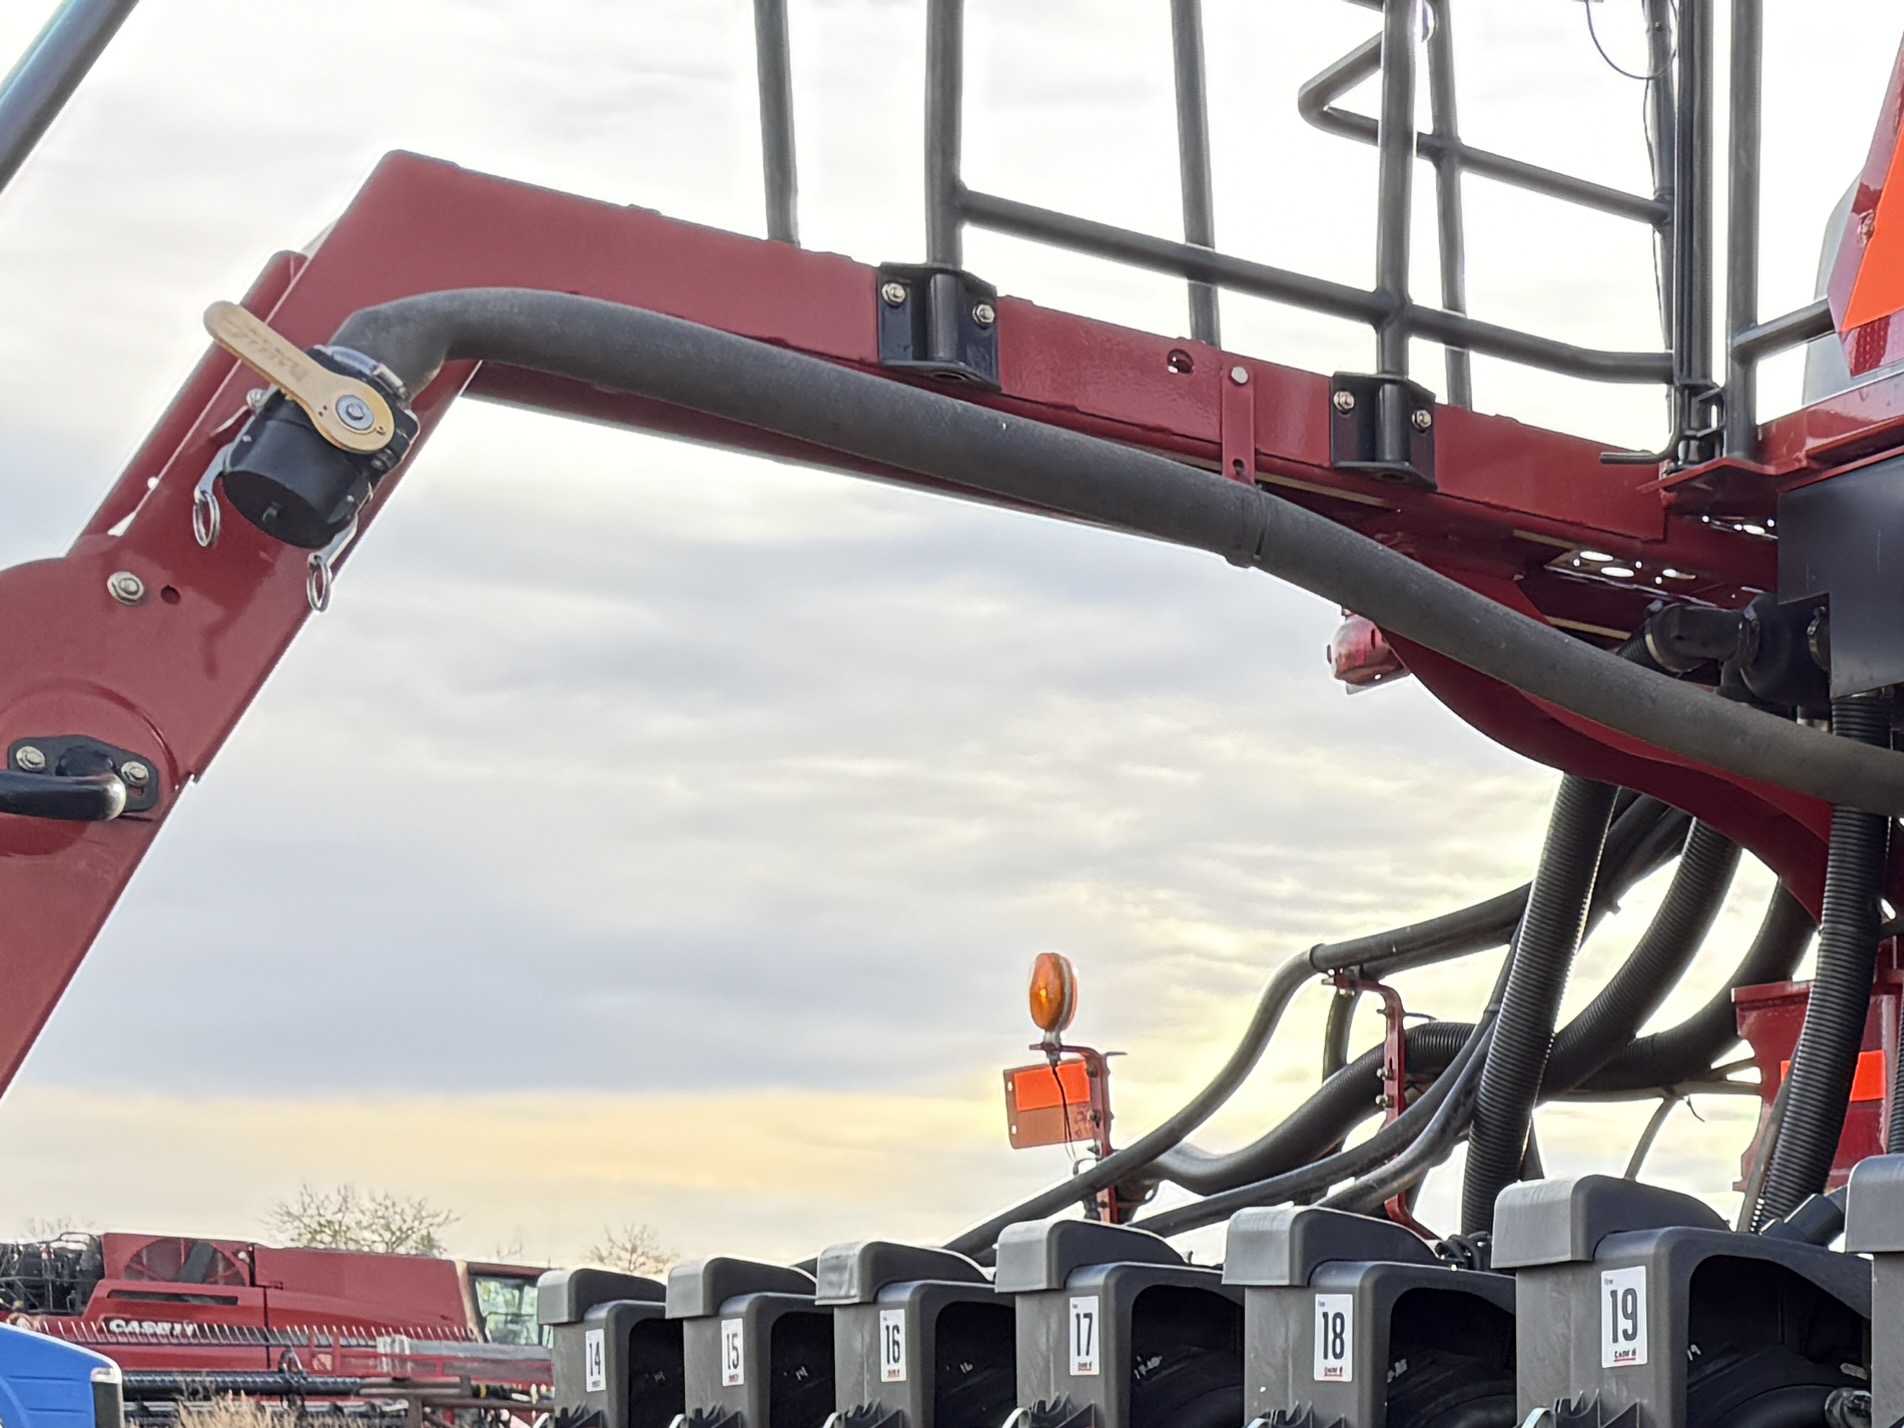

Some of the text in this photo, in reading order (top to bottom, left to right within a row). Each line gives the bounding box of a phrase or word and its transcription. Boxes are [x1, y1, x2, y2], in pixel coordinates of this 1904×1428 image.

[1075, 1312, 1093, 1357] 17
[1322, 1311, 1345, 1360] 18
[1610, 1287, 1638, 1343] 19
[589, 1341, 601, 1377] 14
[726, 1332, 740, 1370] 15
[885, 1324, 901, 1365] 16
